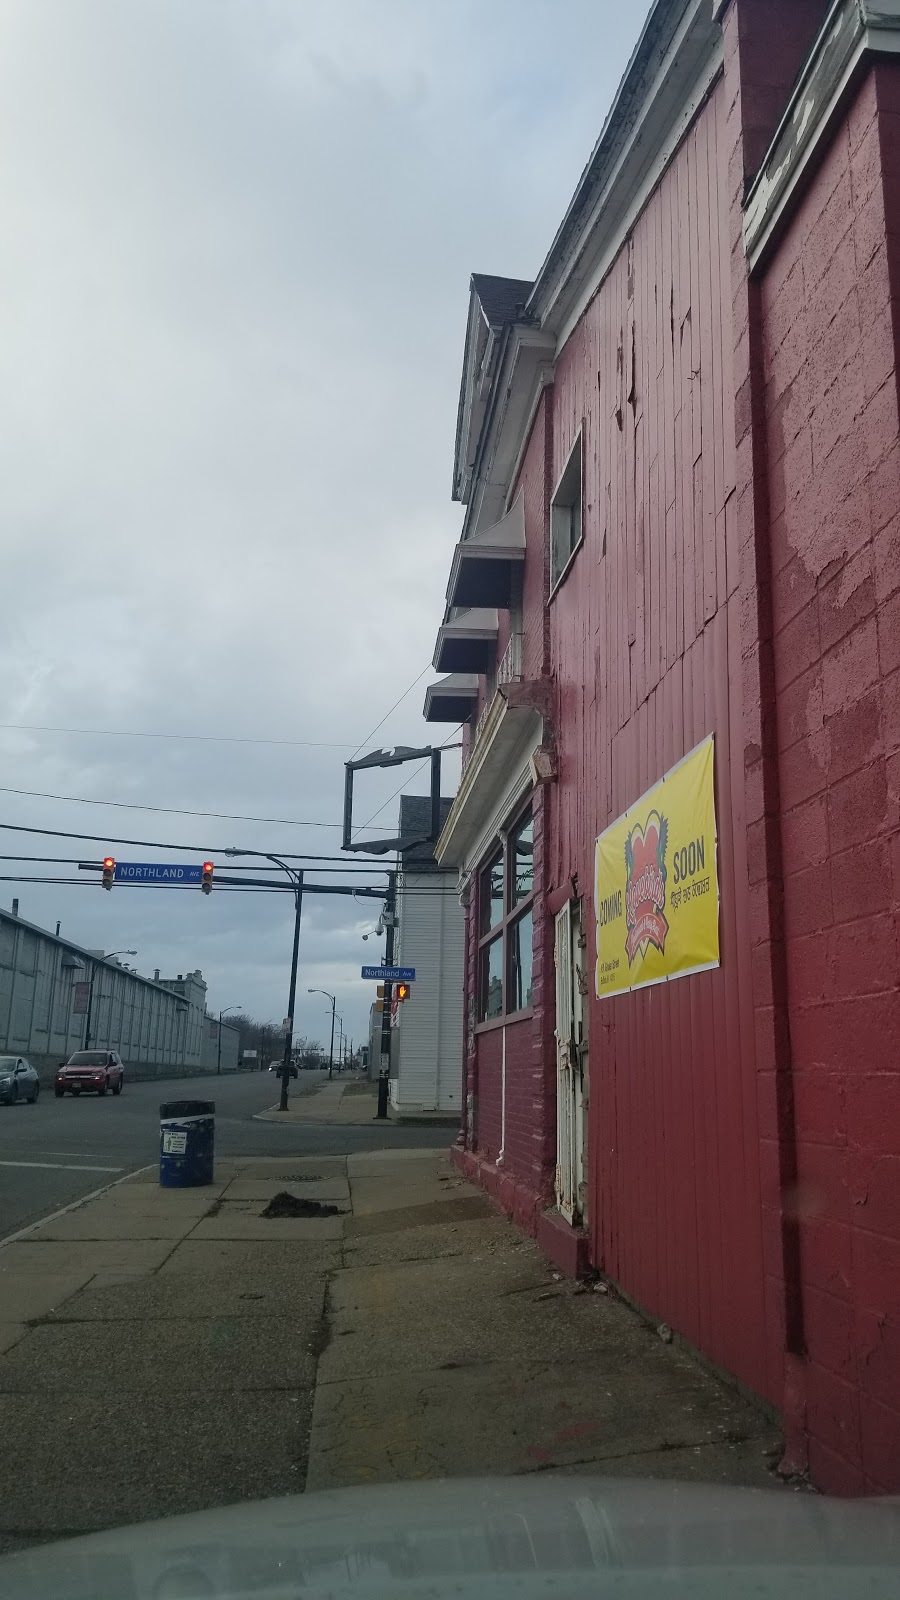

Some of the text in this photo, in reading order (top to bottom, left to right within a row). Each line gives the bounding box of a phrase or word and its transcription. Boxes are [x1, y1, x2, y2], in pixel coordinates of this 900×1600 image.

[121, 867, 184, 878] NORTHLAND
[600, 890, 622, 927] COMING
[673, 835, 704, 884] SOON
[365, 969, 399, 977] Northland
